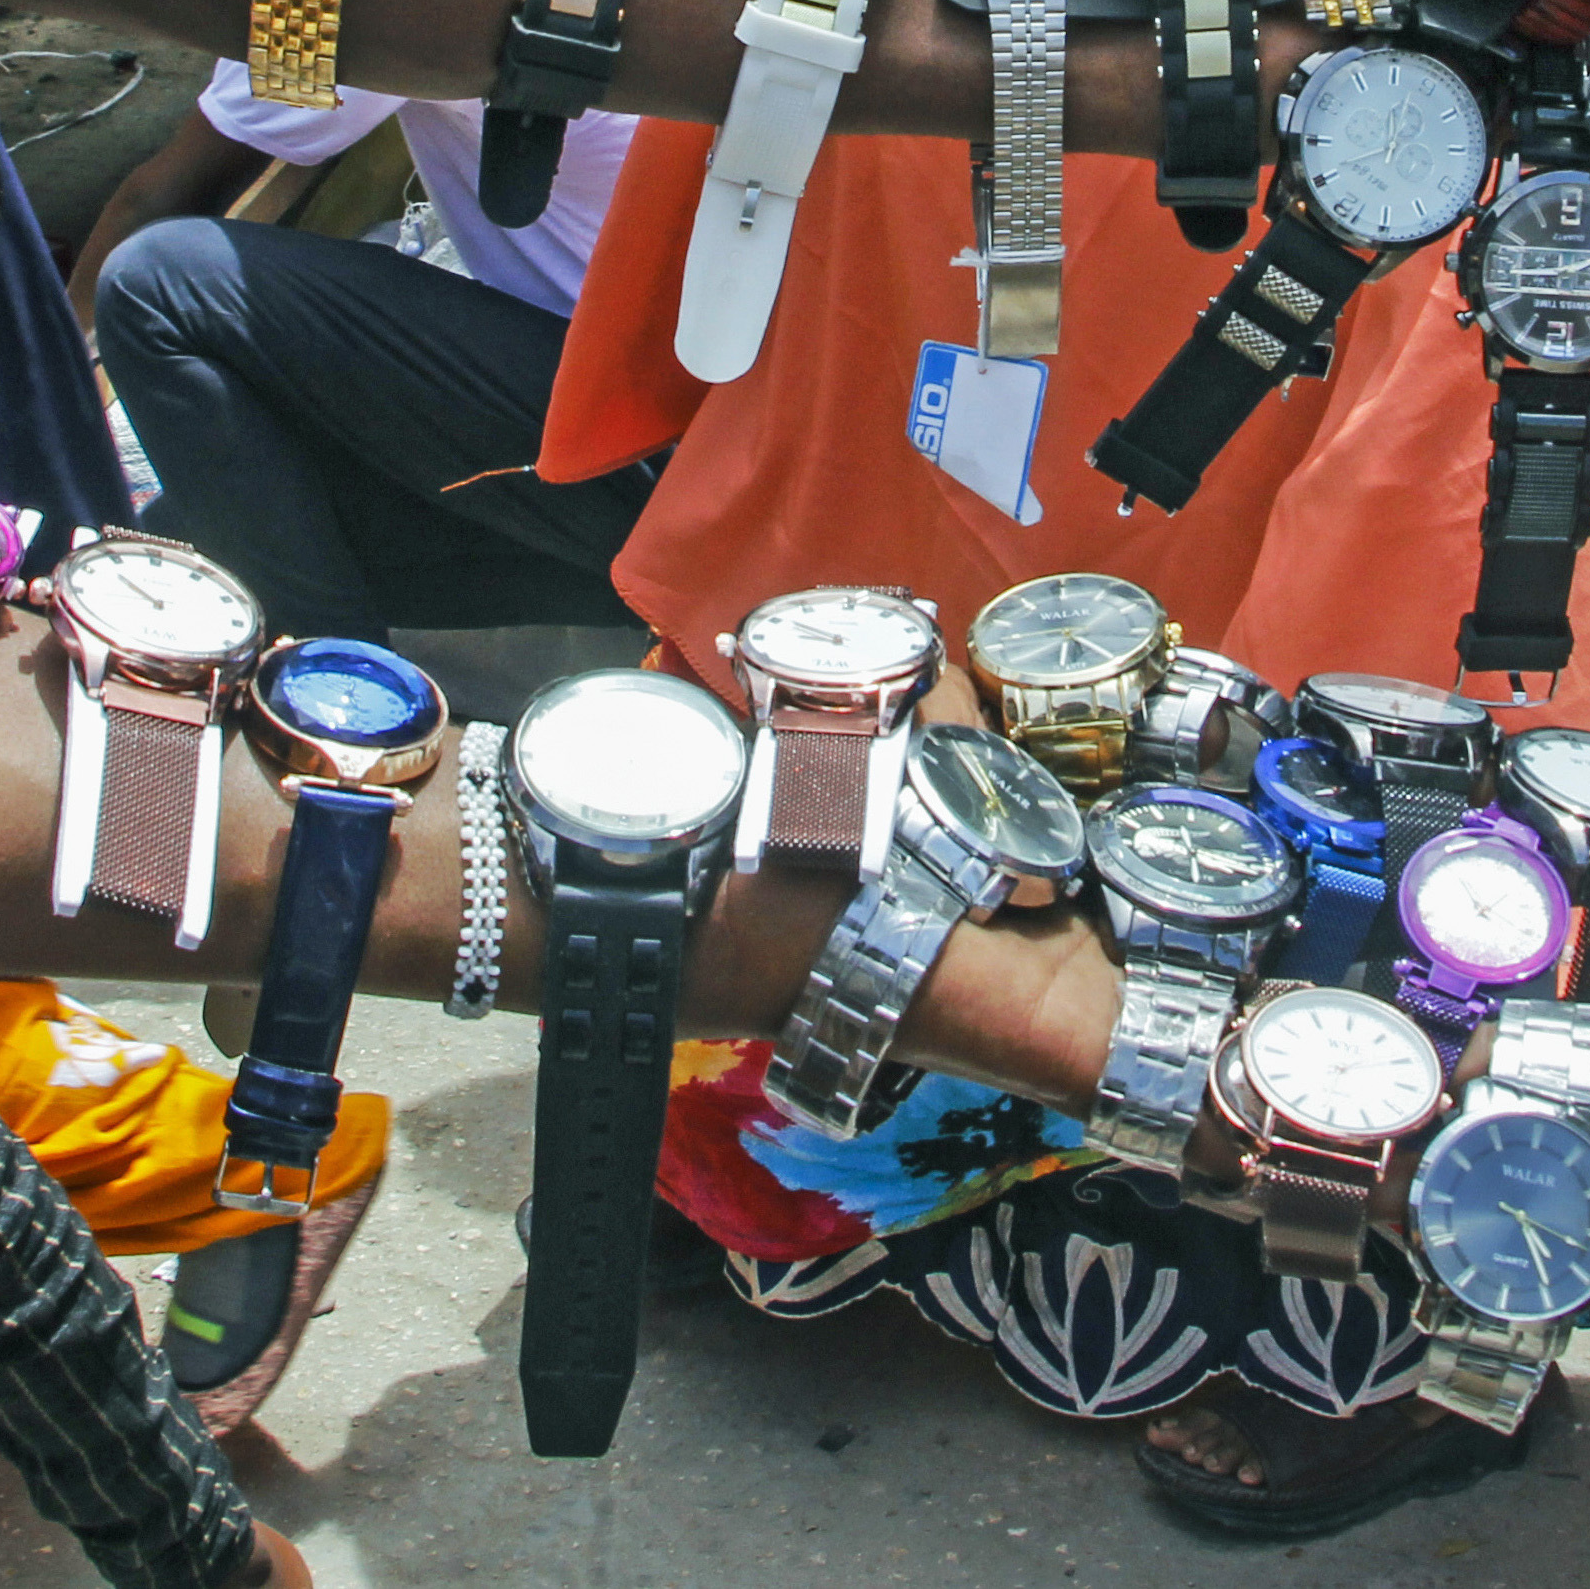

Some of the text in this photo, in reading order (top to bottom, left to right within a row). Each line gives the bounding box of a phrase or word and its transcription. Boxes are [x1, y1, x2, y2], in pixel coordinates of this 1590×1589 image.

[913, 382, 949, 460] SIO
[1039, 609, 1092, 621] WALAR
[987, 769, 1032, 810] WALAR
[1502, 1163, 1556, 1188] WALAR
